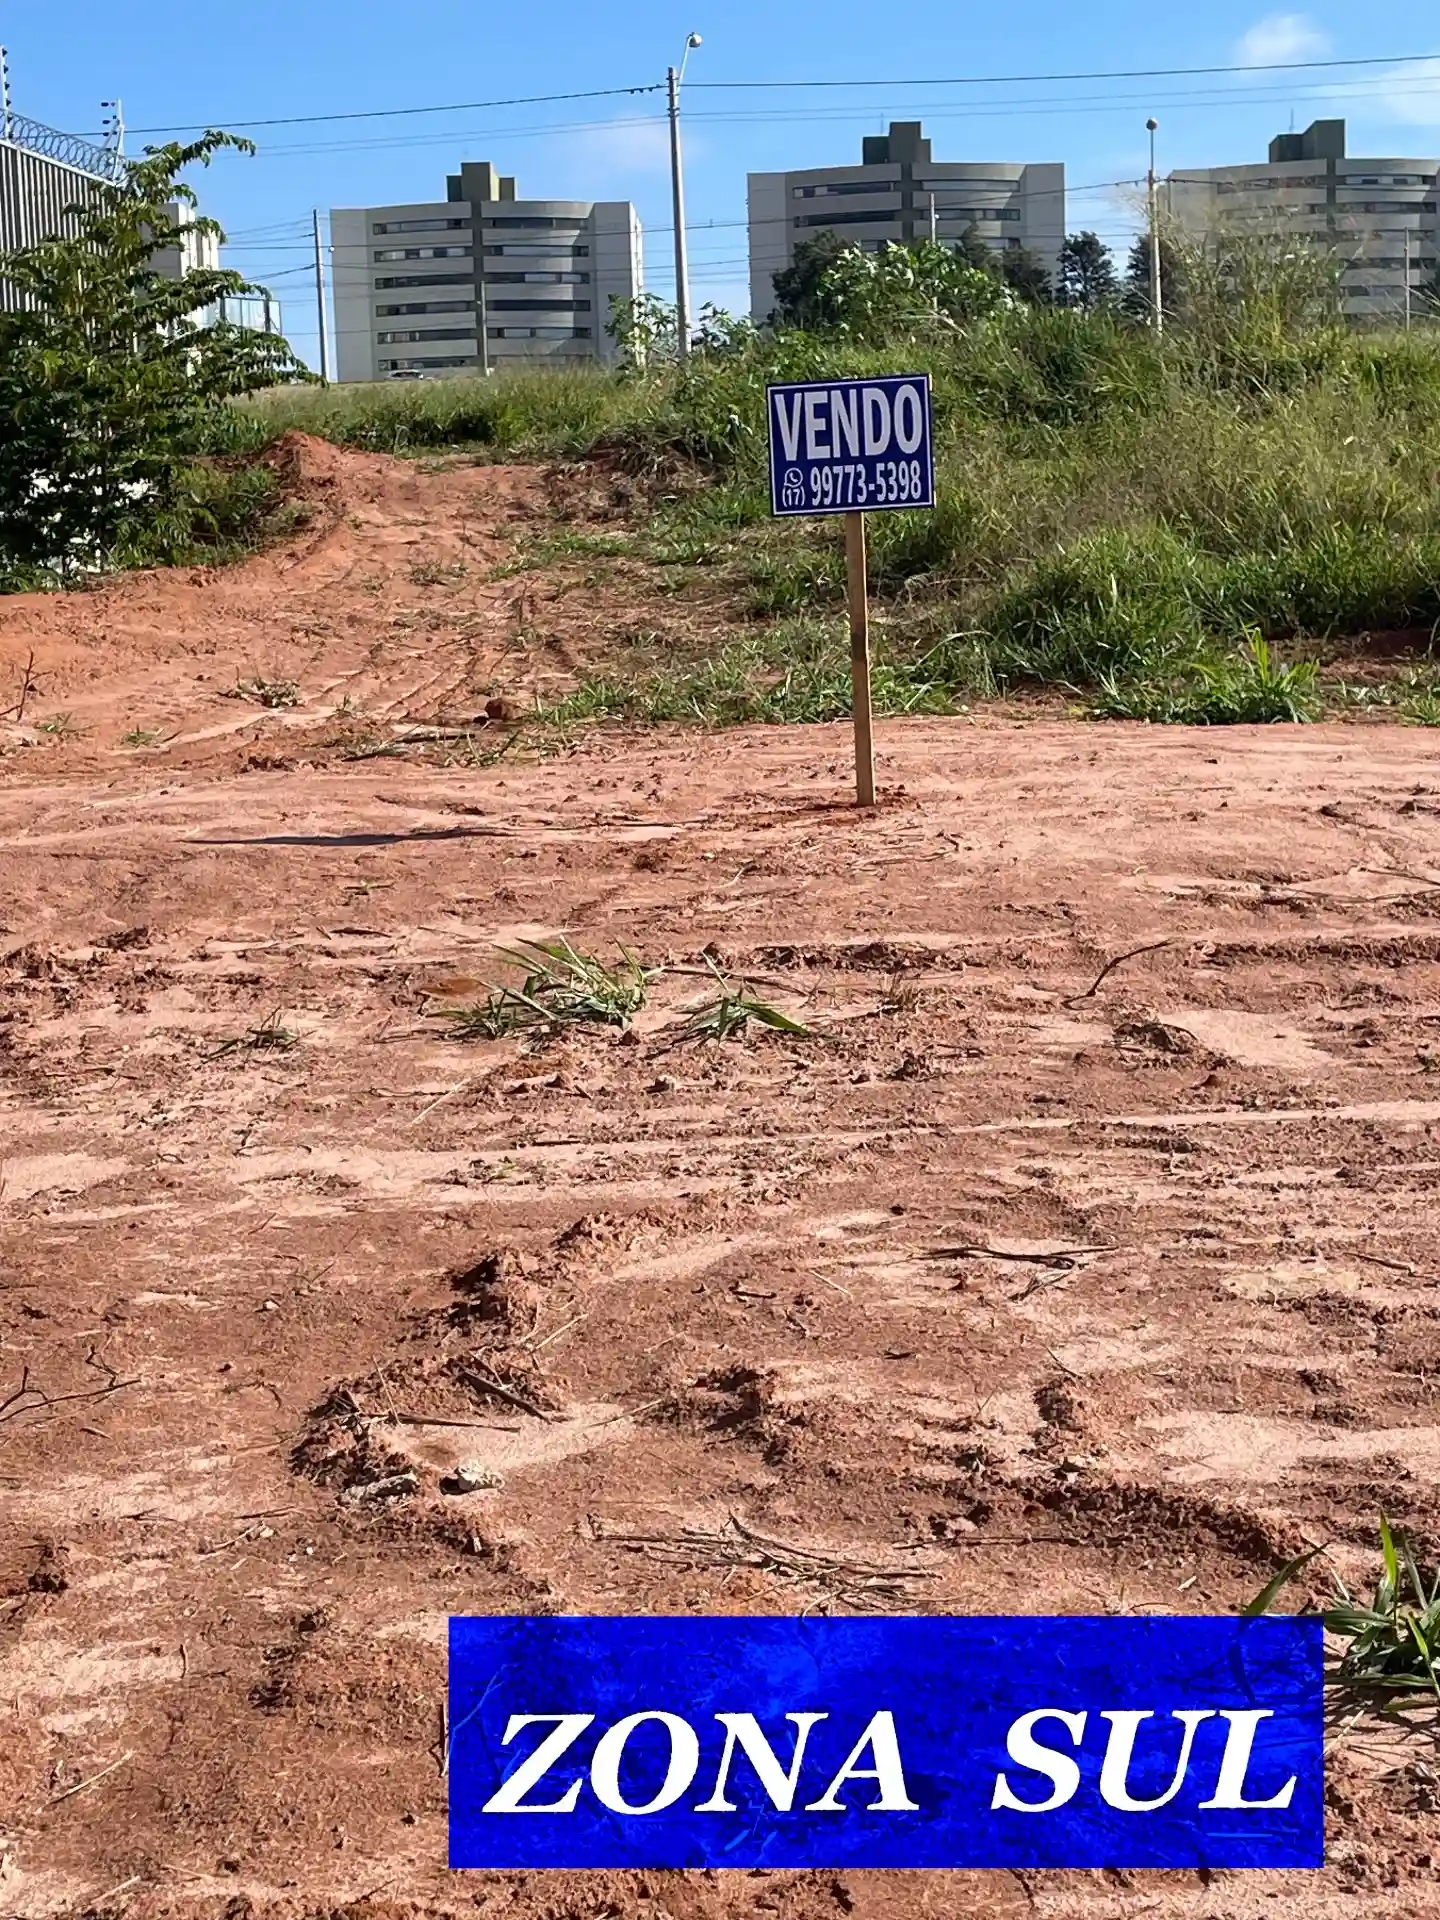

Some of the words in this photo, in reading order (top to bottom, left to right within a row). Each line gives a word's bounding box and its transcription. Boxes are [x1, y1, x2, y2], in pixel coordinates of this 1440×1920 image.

[774, 384, 923, 461] VENDO
[782, 486, 806, 508] (17)
[810, 460, 922, 506] 99773-5398
